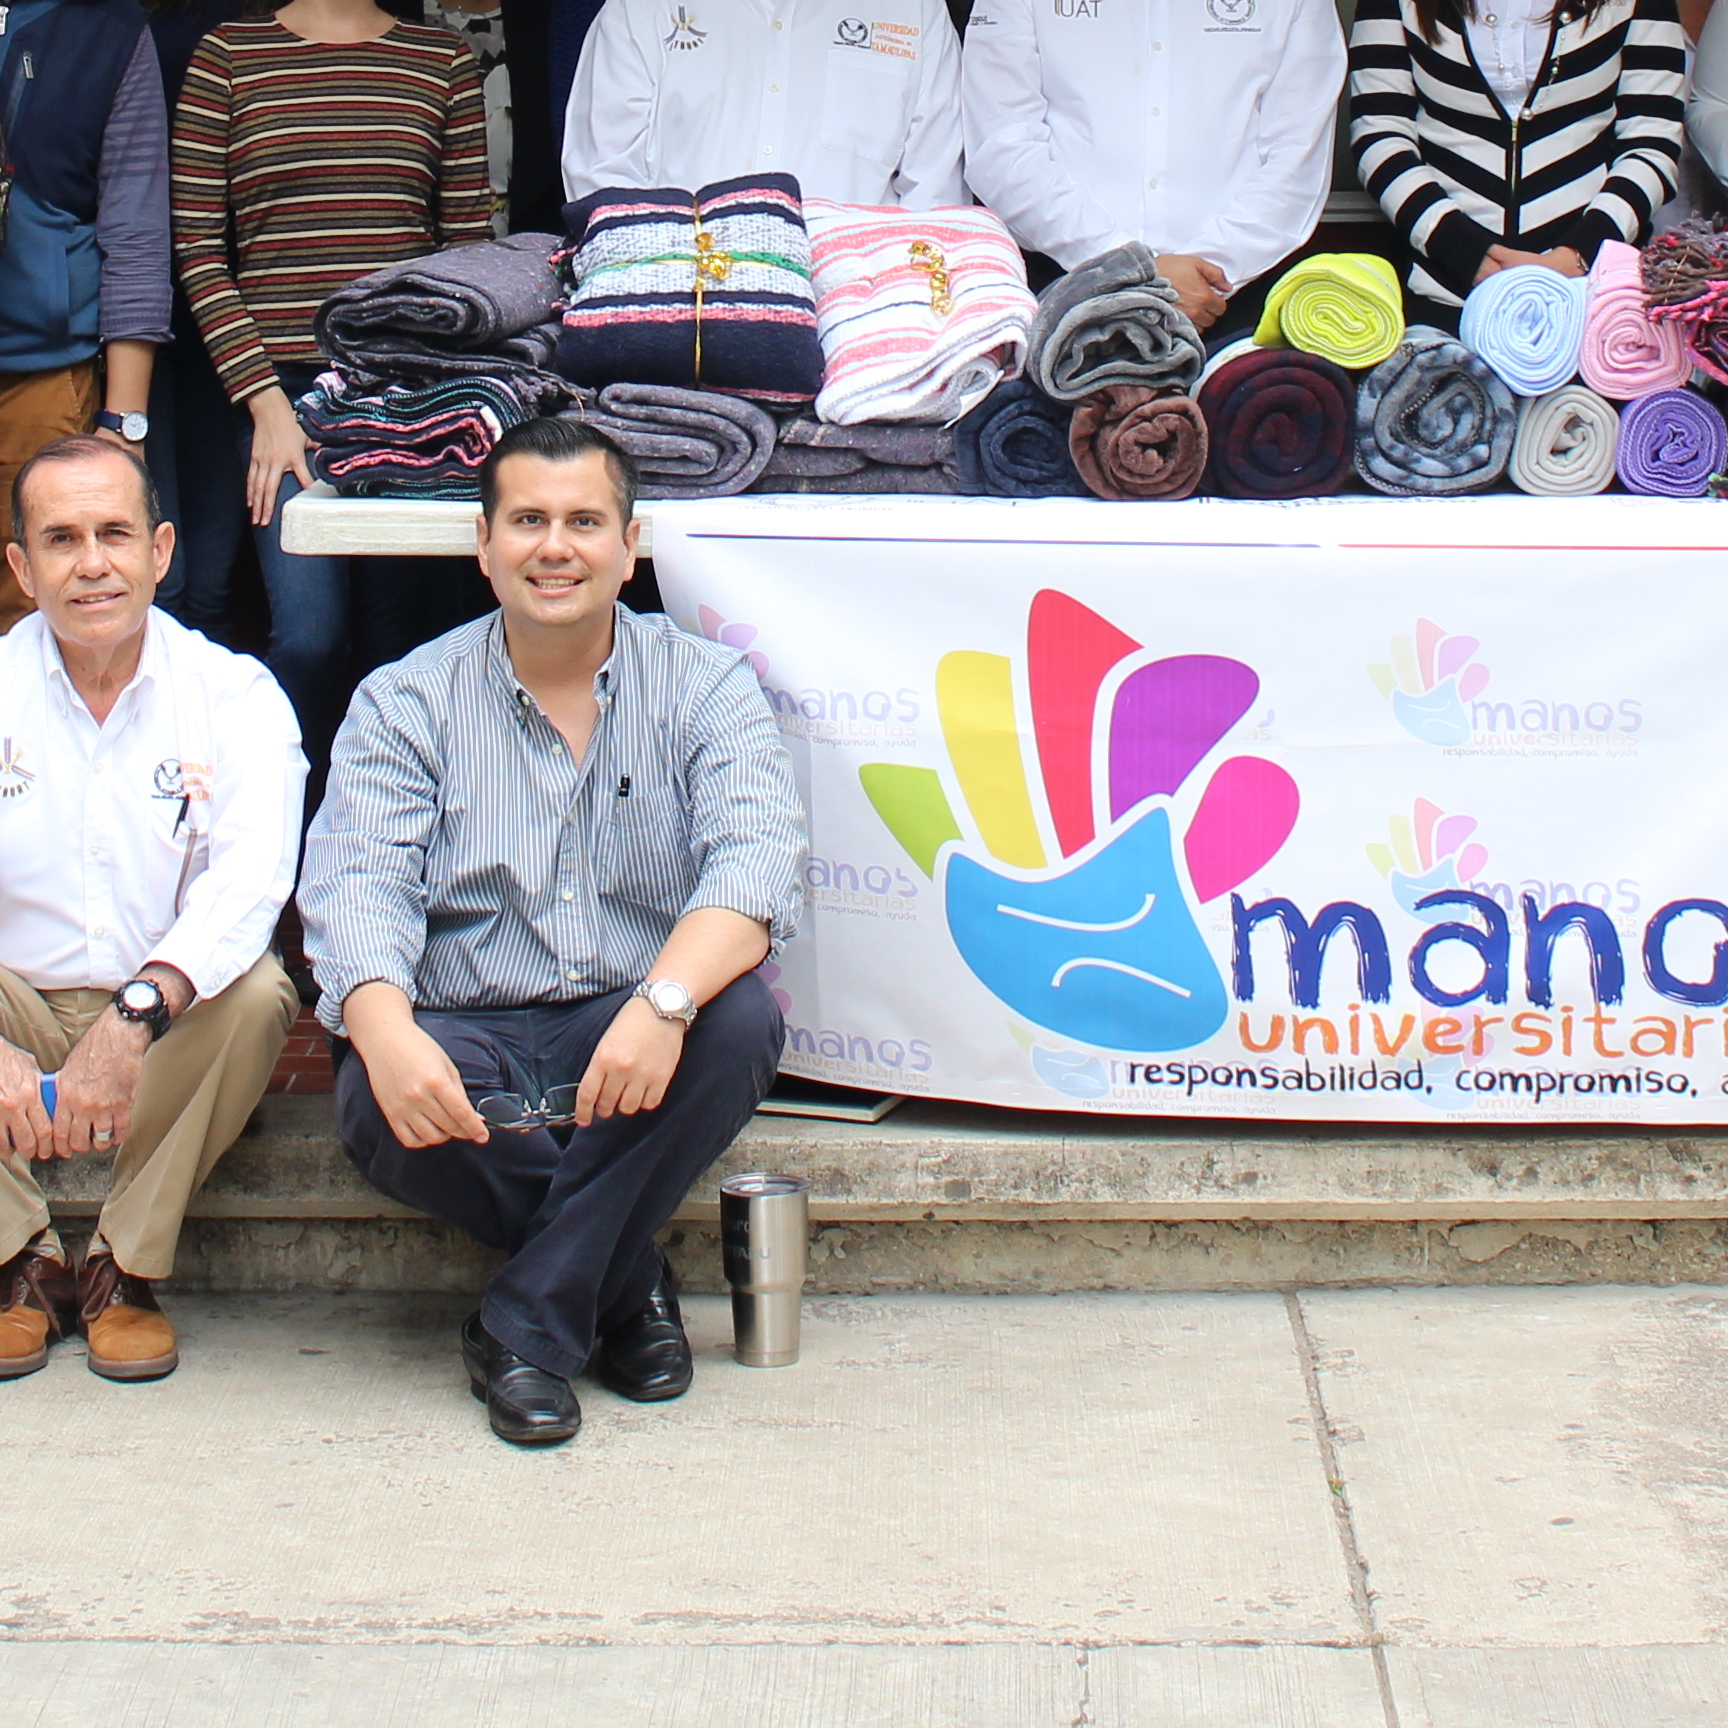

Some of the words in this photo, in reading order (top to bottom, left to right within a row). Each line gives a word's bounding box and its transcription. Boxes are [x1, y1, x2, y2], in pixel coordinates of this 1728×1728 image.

[772, 713, 918, 738] niversitarias
[1470, 697, 1644, 734] manos
[1472, 730, 1639, 747] universitarias
[805, 856, 920, 899] anos
[1129, 1056, 1434, 1097] responsabilidad,
[1455, 1065, 1698, 1104] compromiso,
